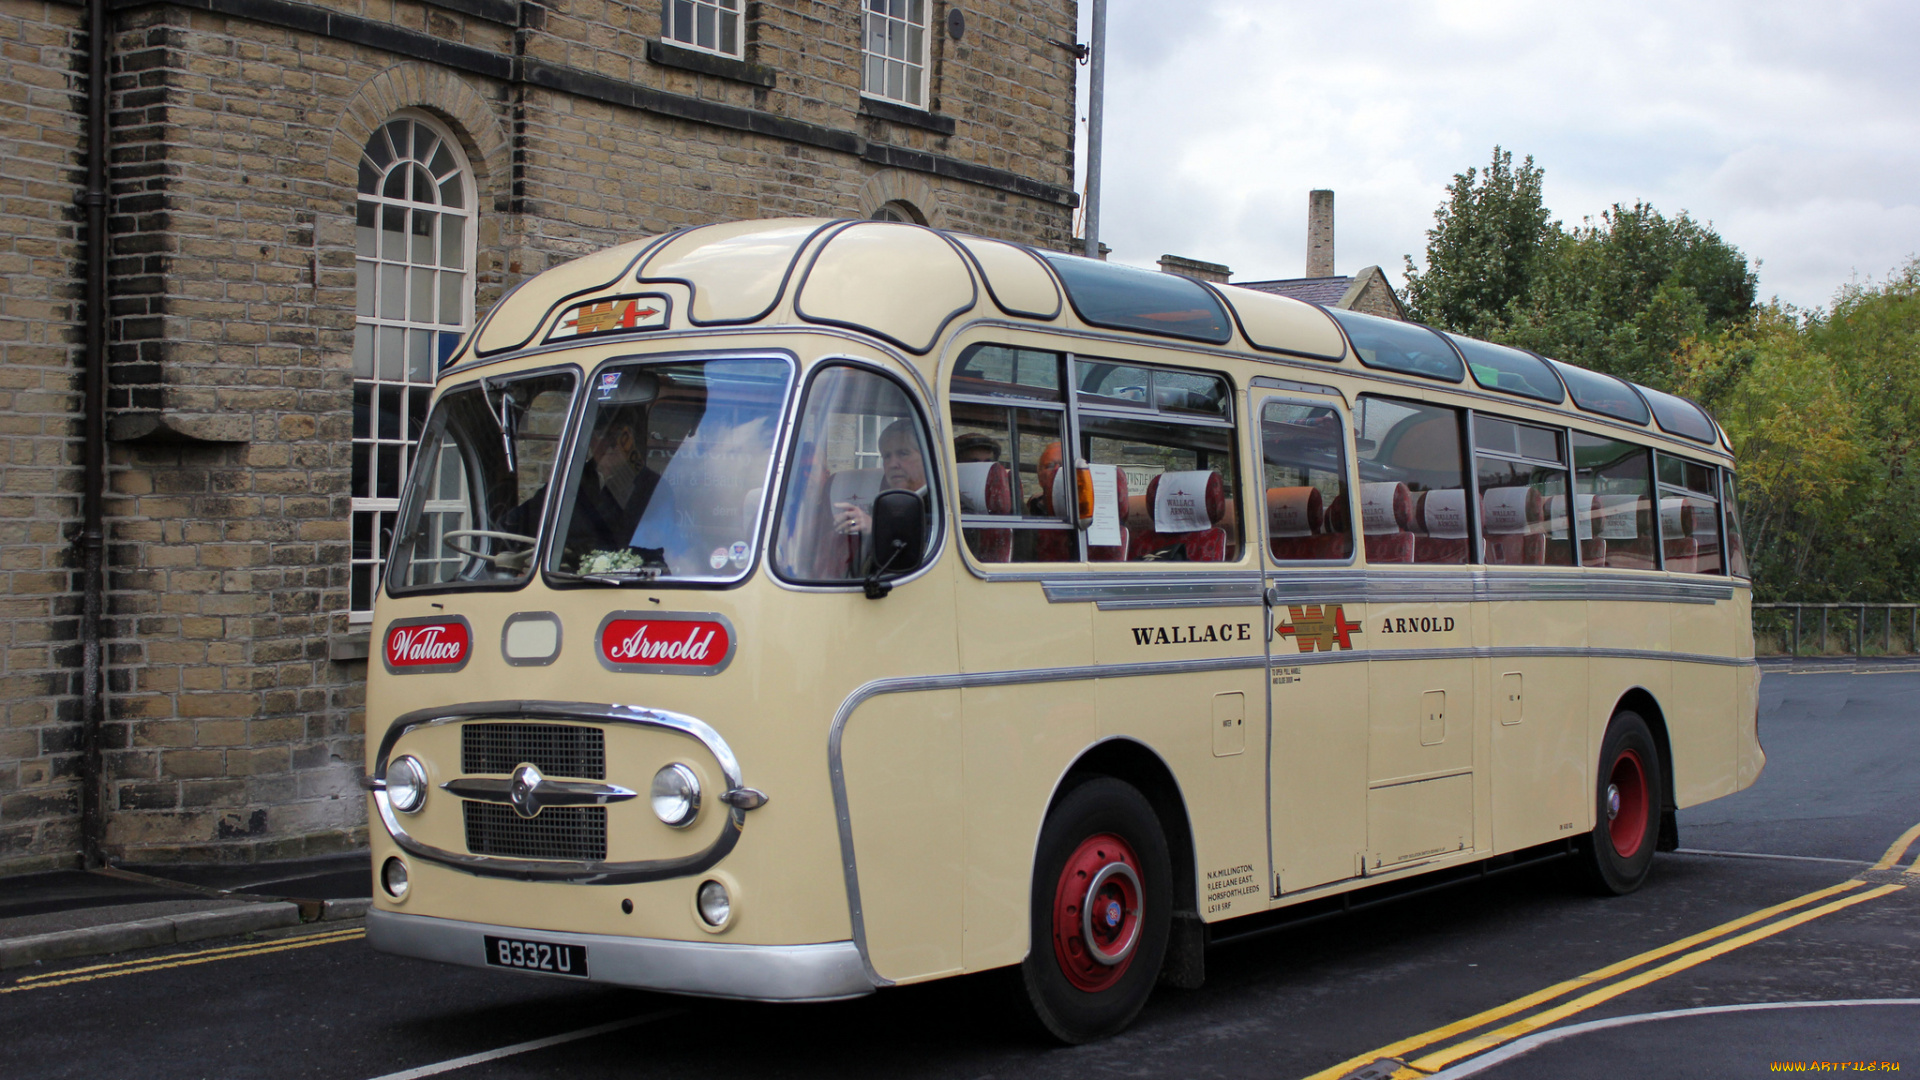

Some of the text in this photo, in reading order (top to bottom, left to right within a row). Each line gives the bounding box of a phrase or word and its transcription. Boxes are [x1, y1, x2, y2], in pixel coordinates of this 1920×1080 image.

[393, 626, 460, 660] Wallace
[611, 624, 716, 660] Arnold
[1131, 617, 1455, 646] WALLACE ARNOLD
[1223, 878, 1238, 888] LANE
